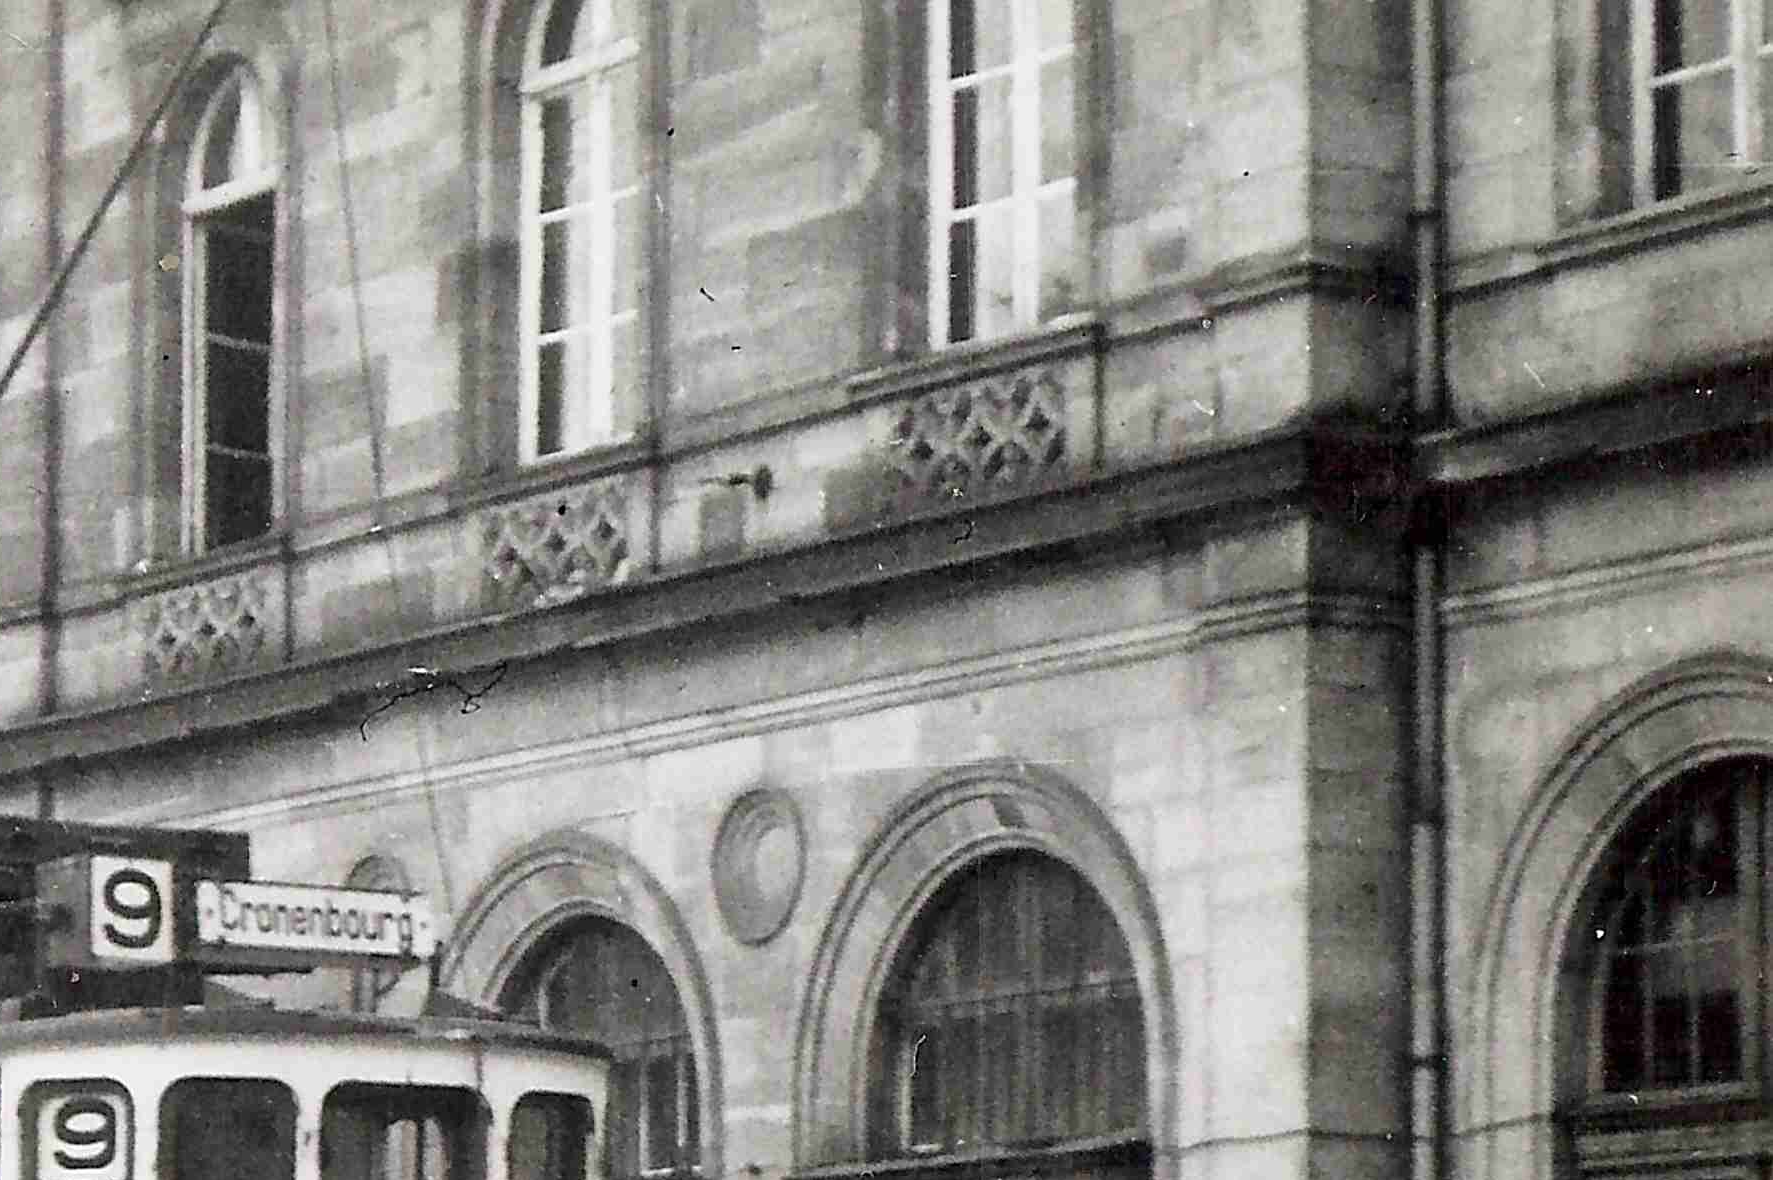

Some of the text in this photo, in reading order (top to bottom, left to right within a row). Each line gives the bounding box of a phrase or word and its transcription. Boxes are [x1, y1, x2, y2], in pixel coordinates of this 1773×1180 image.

[102, 867, 163, 949] 9
[221, 887, 414, 950] Cronenbourg
[53, 1095, 117, 1171] 9
